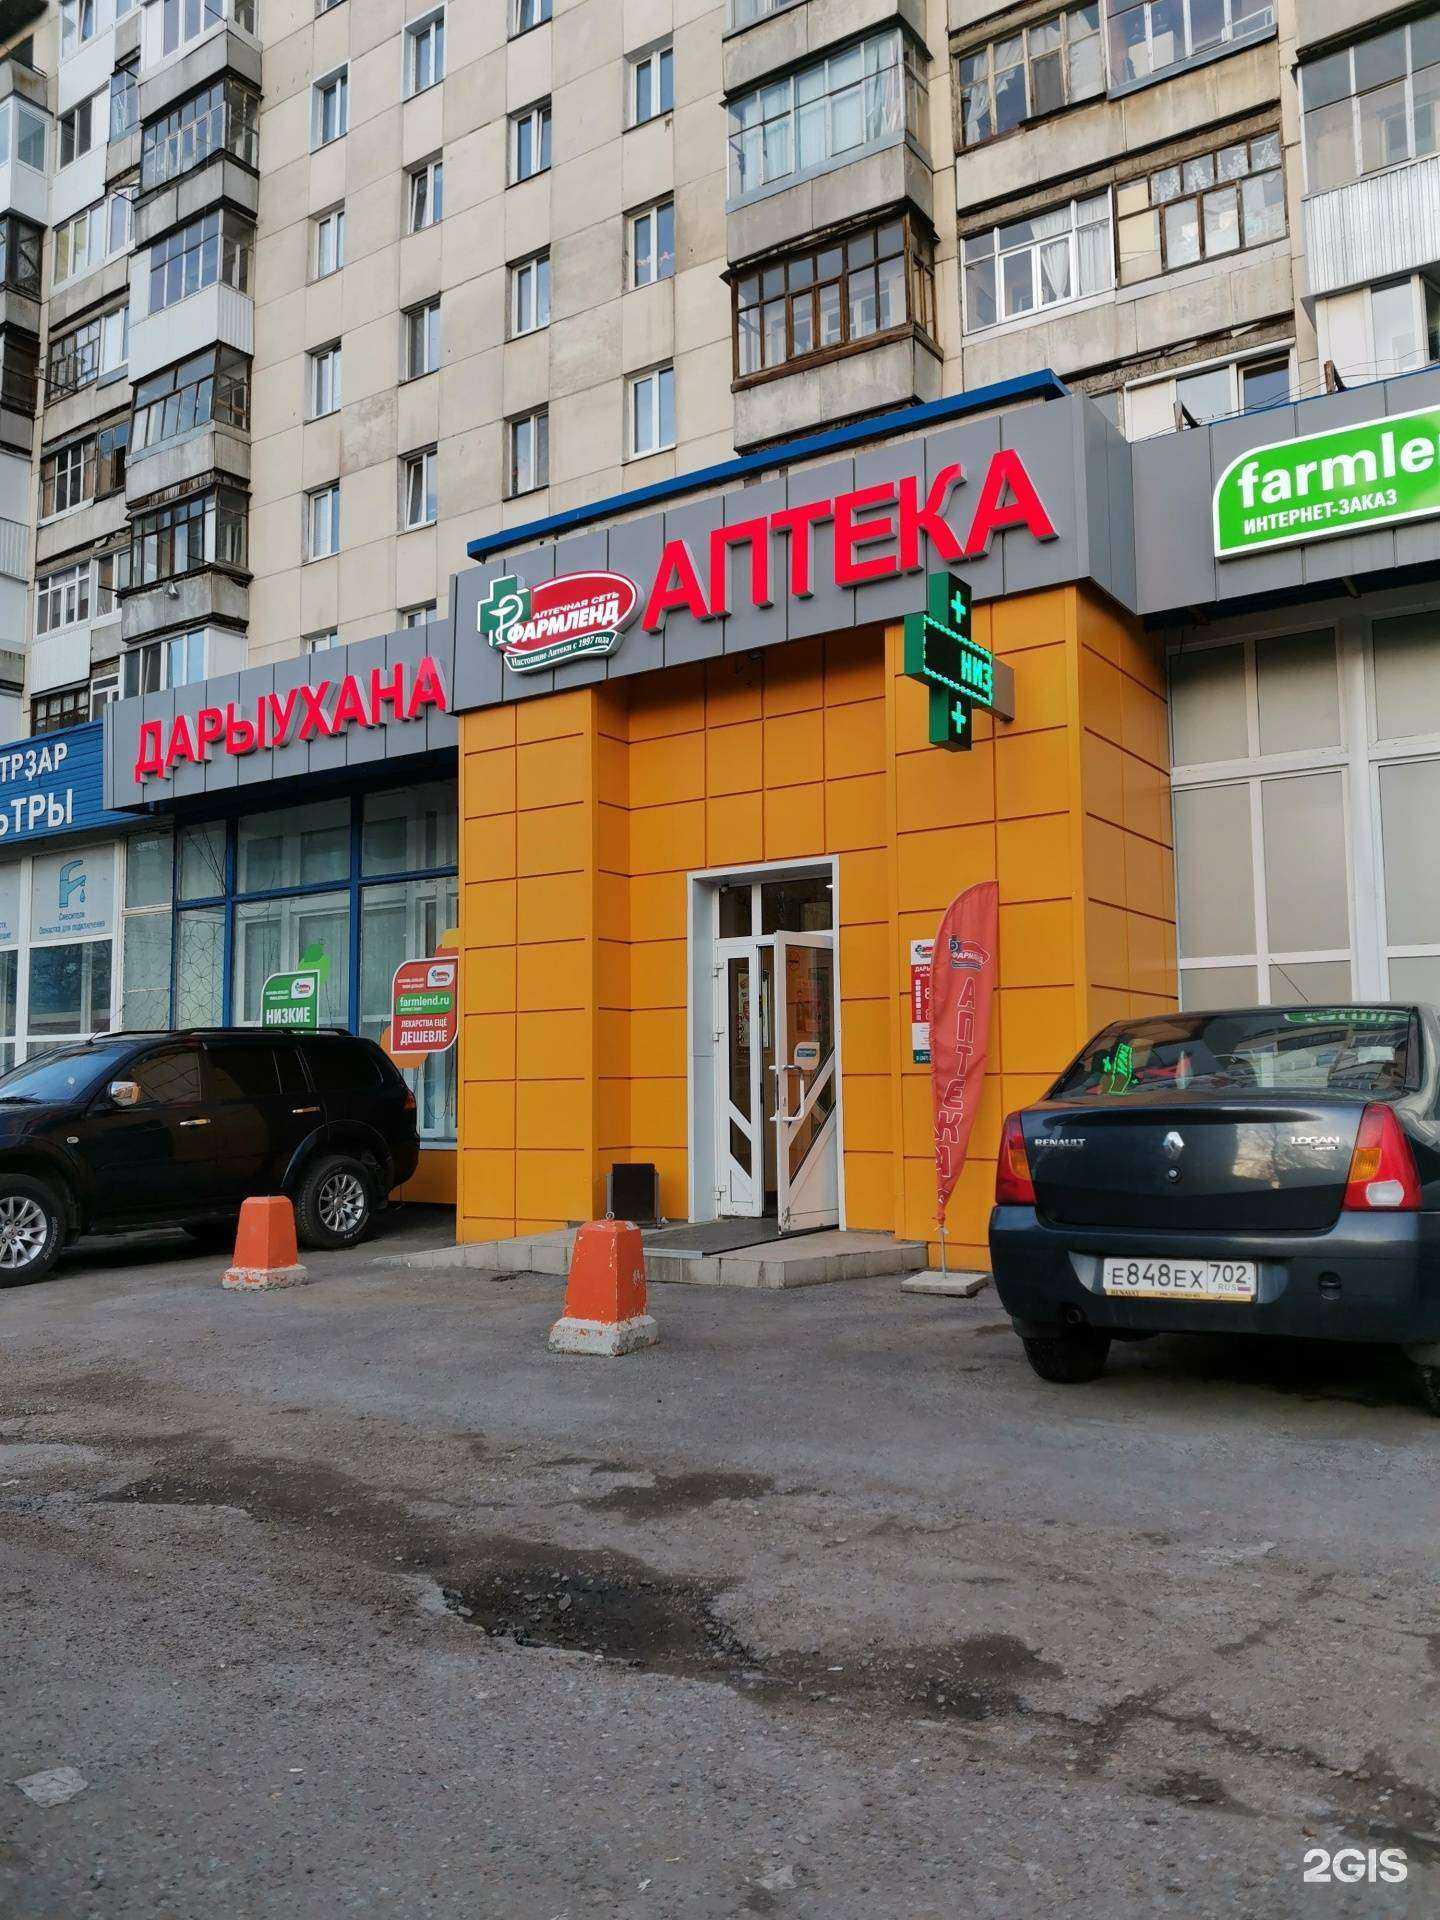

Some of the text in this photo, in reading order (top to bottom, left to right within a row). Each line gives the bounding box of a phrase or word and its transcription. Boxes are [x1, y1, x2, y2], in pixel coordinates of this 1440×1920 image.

[1238, 432, 1440, 508] farmle
[1243, 489, 1398, 536] ИНТЕРНЕТ-ЗАКАЗ
[642, 449, 1059, 633] АПТЕКА
[533, 592, 620, 620] АПТЕЧНАЯ СЕТЬ
[506, 601, 619, 643] ФАРМЛЕНД
[548, 645, 572, 659] Аптеки
[578, 636, 594, 648] 1997
[595, 636, 610, 646] года
[961, 649, 993, 692] НИЗ
[133, 656, 447, 785] ДАРЫУХАНА
[266, 1007, 311, 1025] НИЗКИЕ
[401, 1019, 433, 1029] ЛЕКАРСТВА
[400, 1030, 448, 1046] ДЕШЕВЛЕ
[1033, 1138, 1086, 1147] RENAULT
[1290, 1136, 1340, 1145] LOGAN
[1210, 1264, 1247, 1284] 702
[1217, 1284, 1238, 1292] RUS
